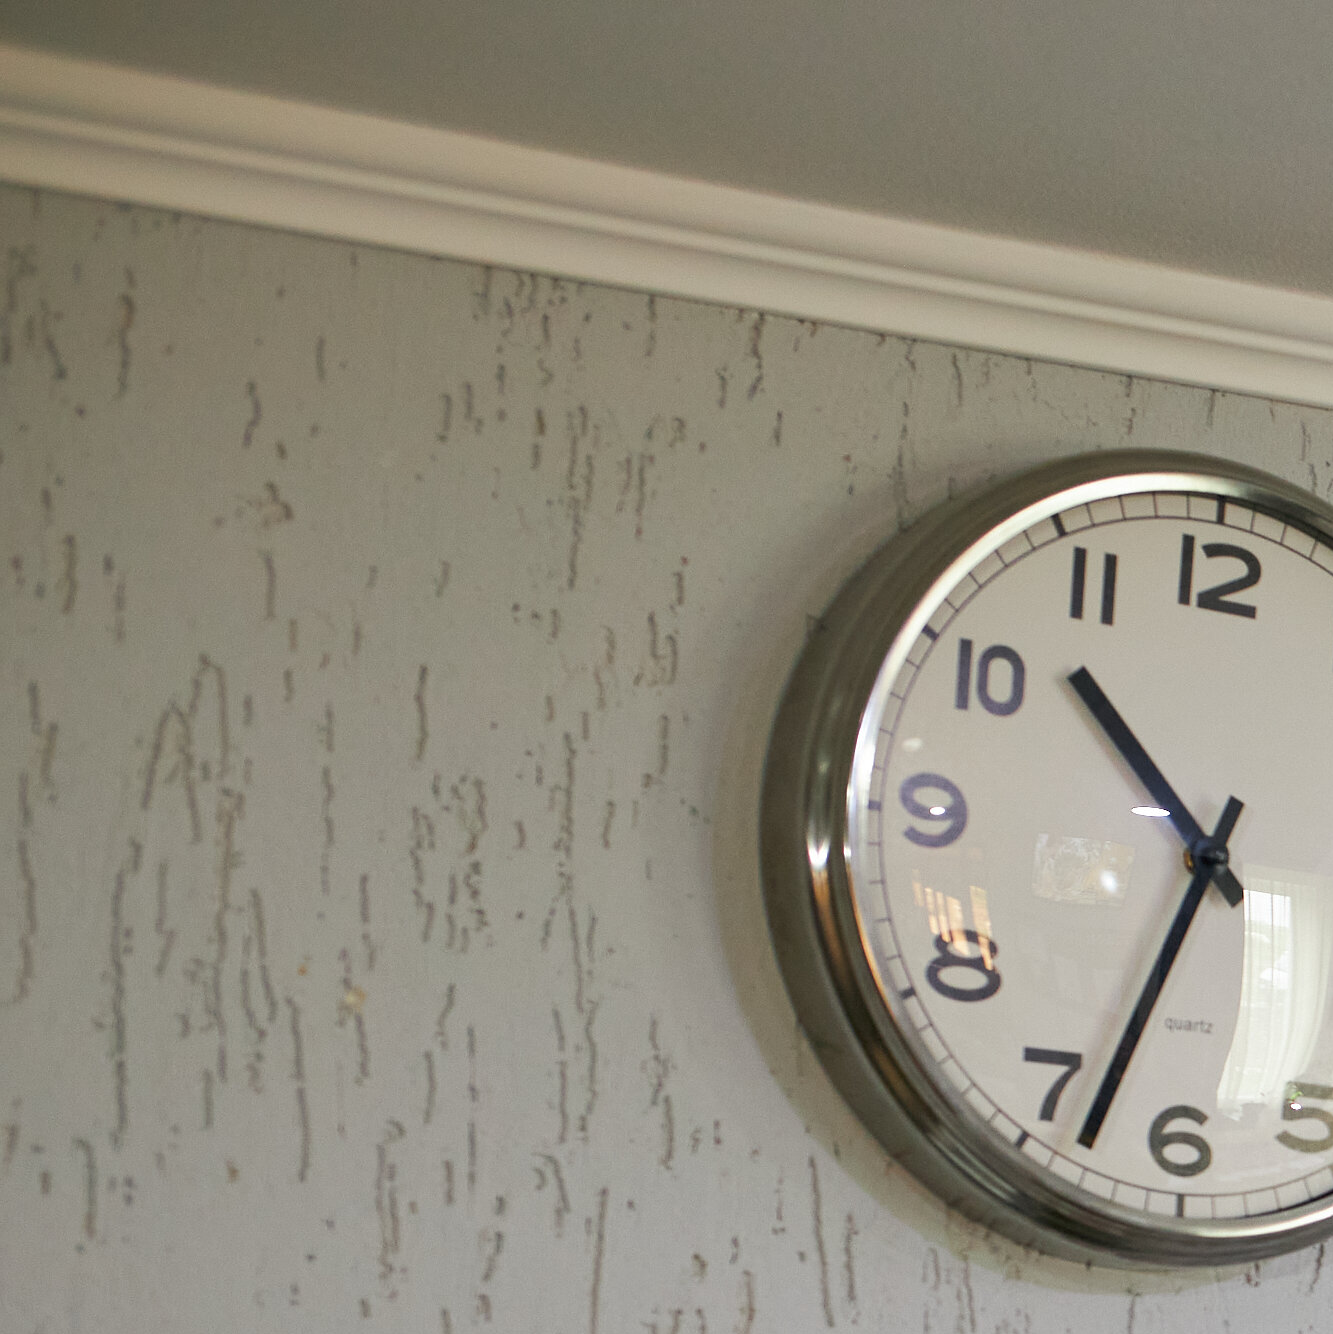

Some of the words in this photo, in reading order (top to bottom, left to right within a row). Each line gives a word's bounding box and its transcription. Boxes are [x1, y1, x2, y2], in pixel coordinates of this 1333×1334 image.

[1070, 547, 1117, 625] 11
[1178, 534, 1261, 618] 12
[955, 639, 1025, 716] 10
[900, 773, 967, 847] 9
[926, 929, 1001, 1001] 8
[1164, 1015, 1213, 1035] quartz
[1023, 1047, 1082, 1122] 7
[1148, 1105, 1211, 1177] 6
